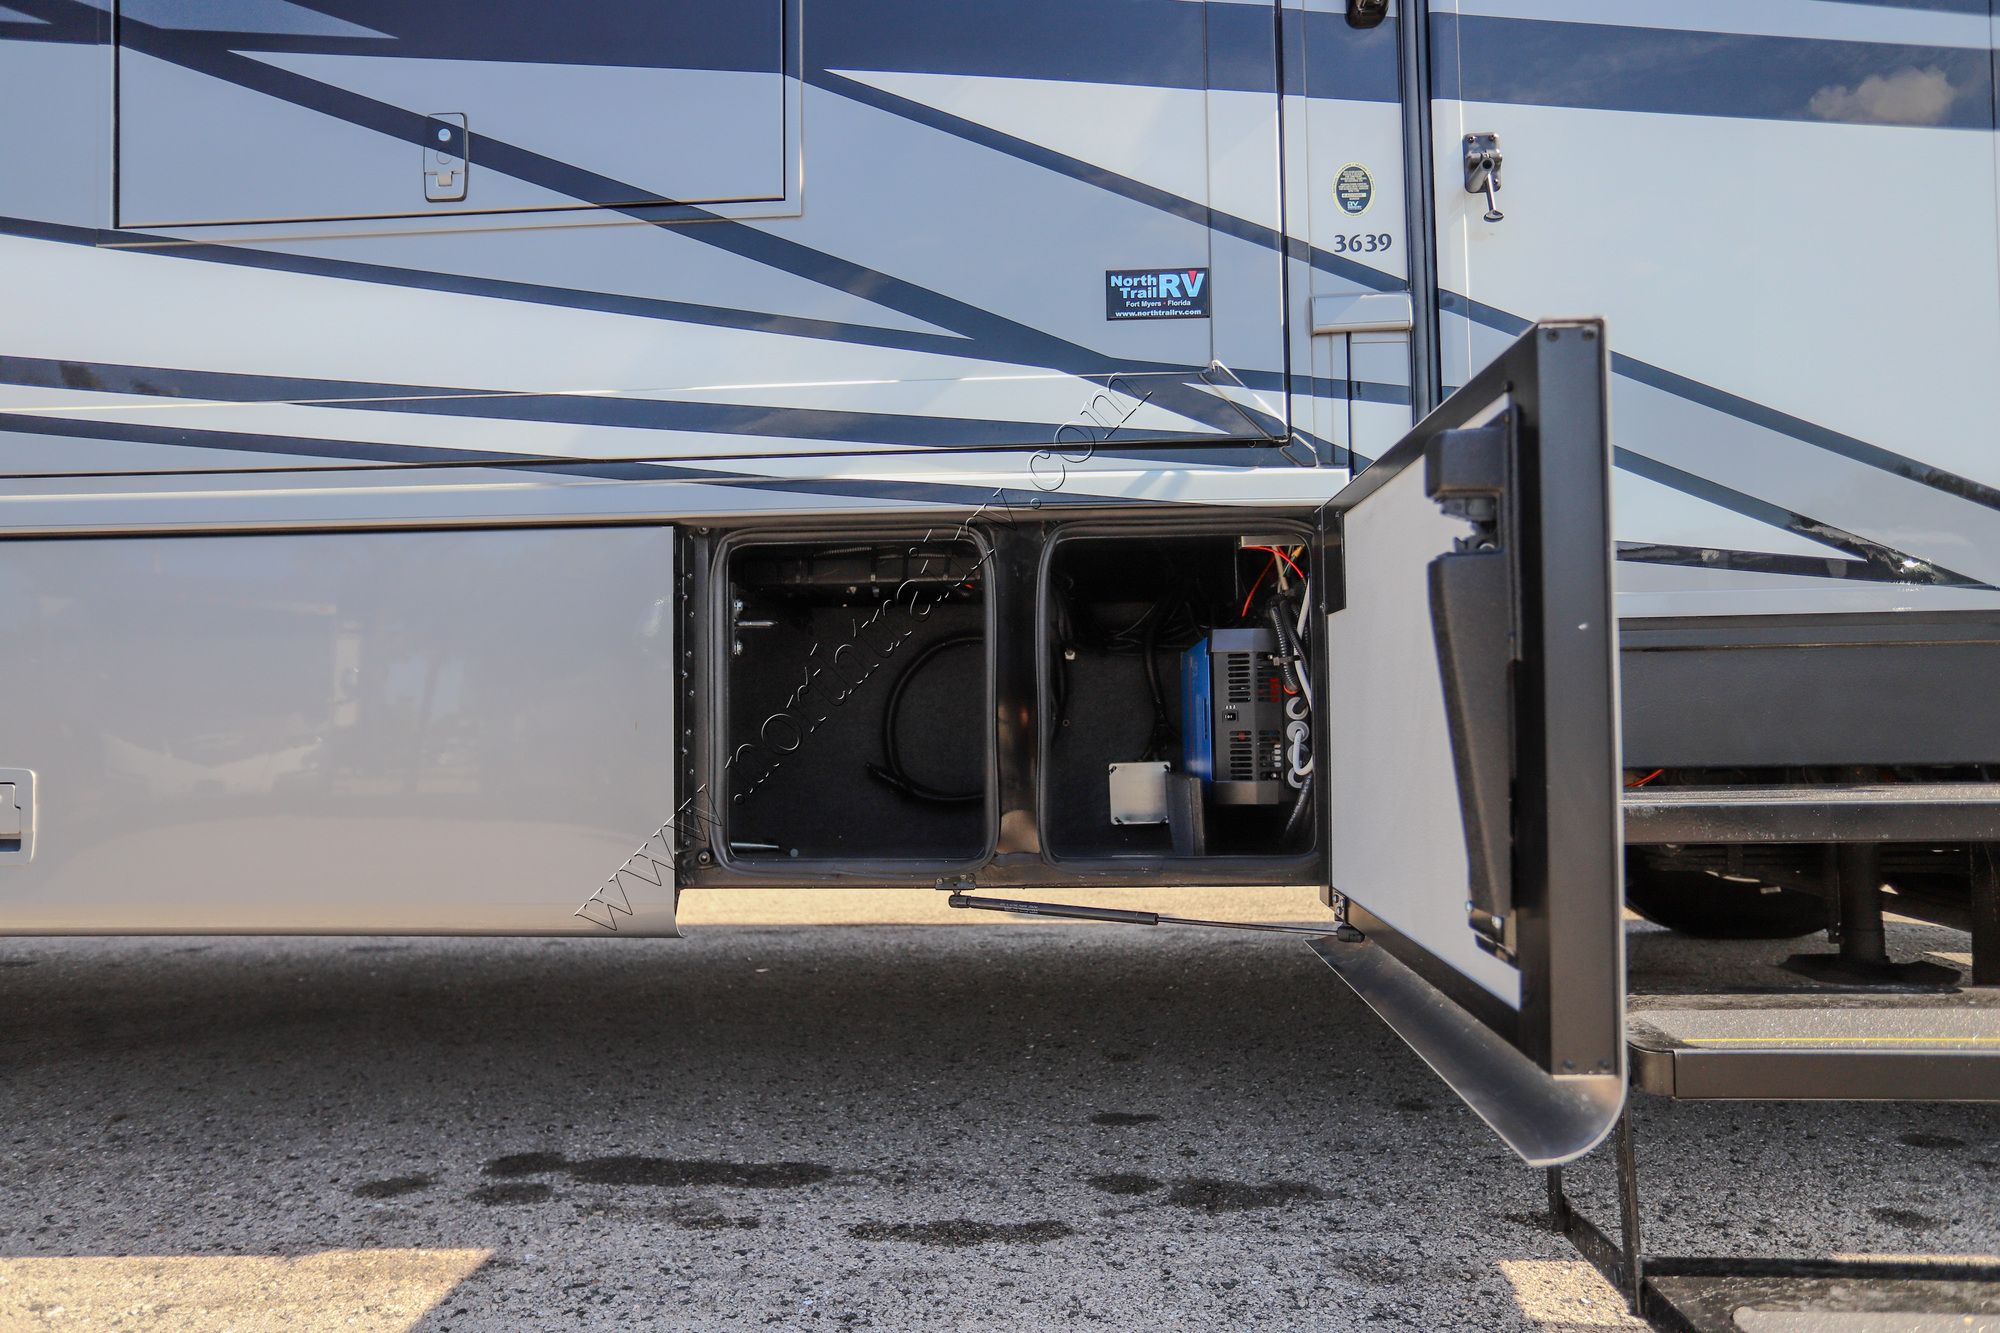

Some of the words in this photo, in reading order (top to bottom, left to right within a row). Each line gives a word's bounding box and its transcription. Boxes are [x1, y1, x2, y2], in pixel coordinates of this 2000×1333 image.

[1334, 233, 1392, 253] 3639
[1110, 274, 1157, 287] North
[1159, 273, 1205, 298] RV
[1120, 287, 1157, 299] Trail
[1126, 300, 1140, 308] Fort
[1141, 300, 1161, 308] Myers
[1167, 299, 1191, 307] Florida
[1115, 309, 1202, 317] www.northtrailrv.com
